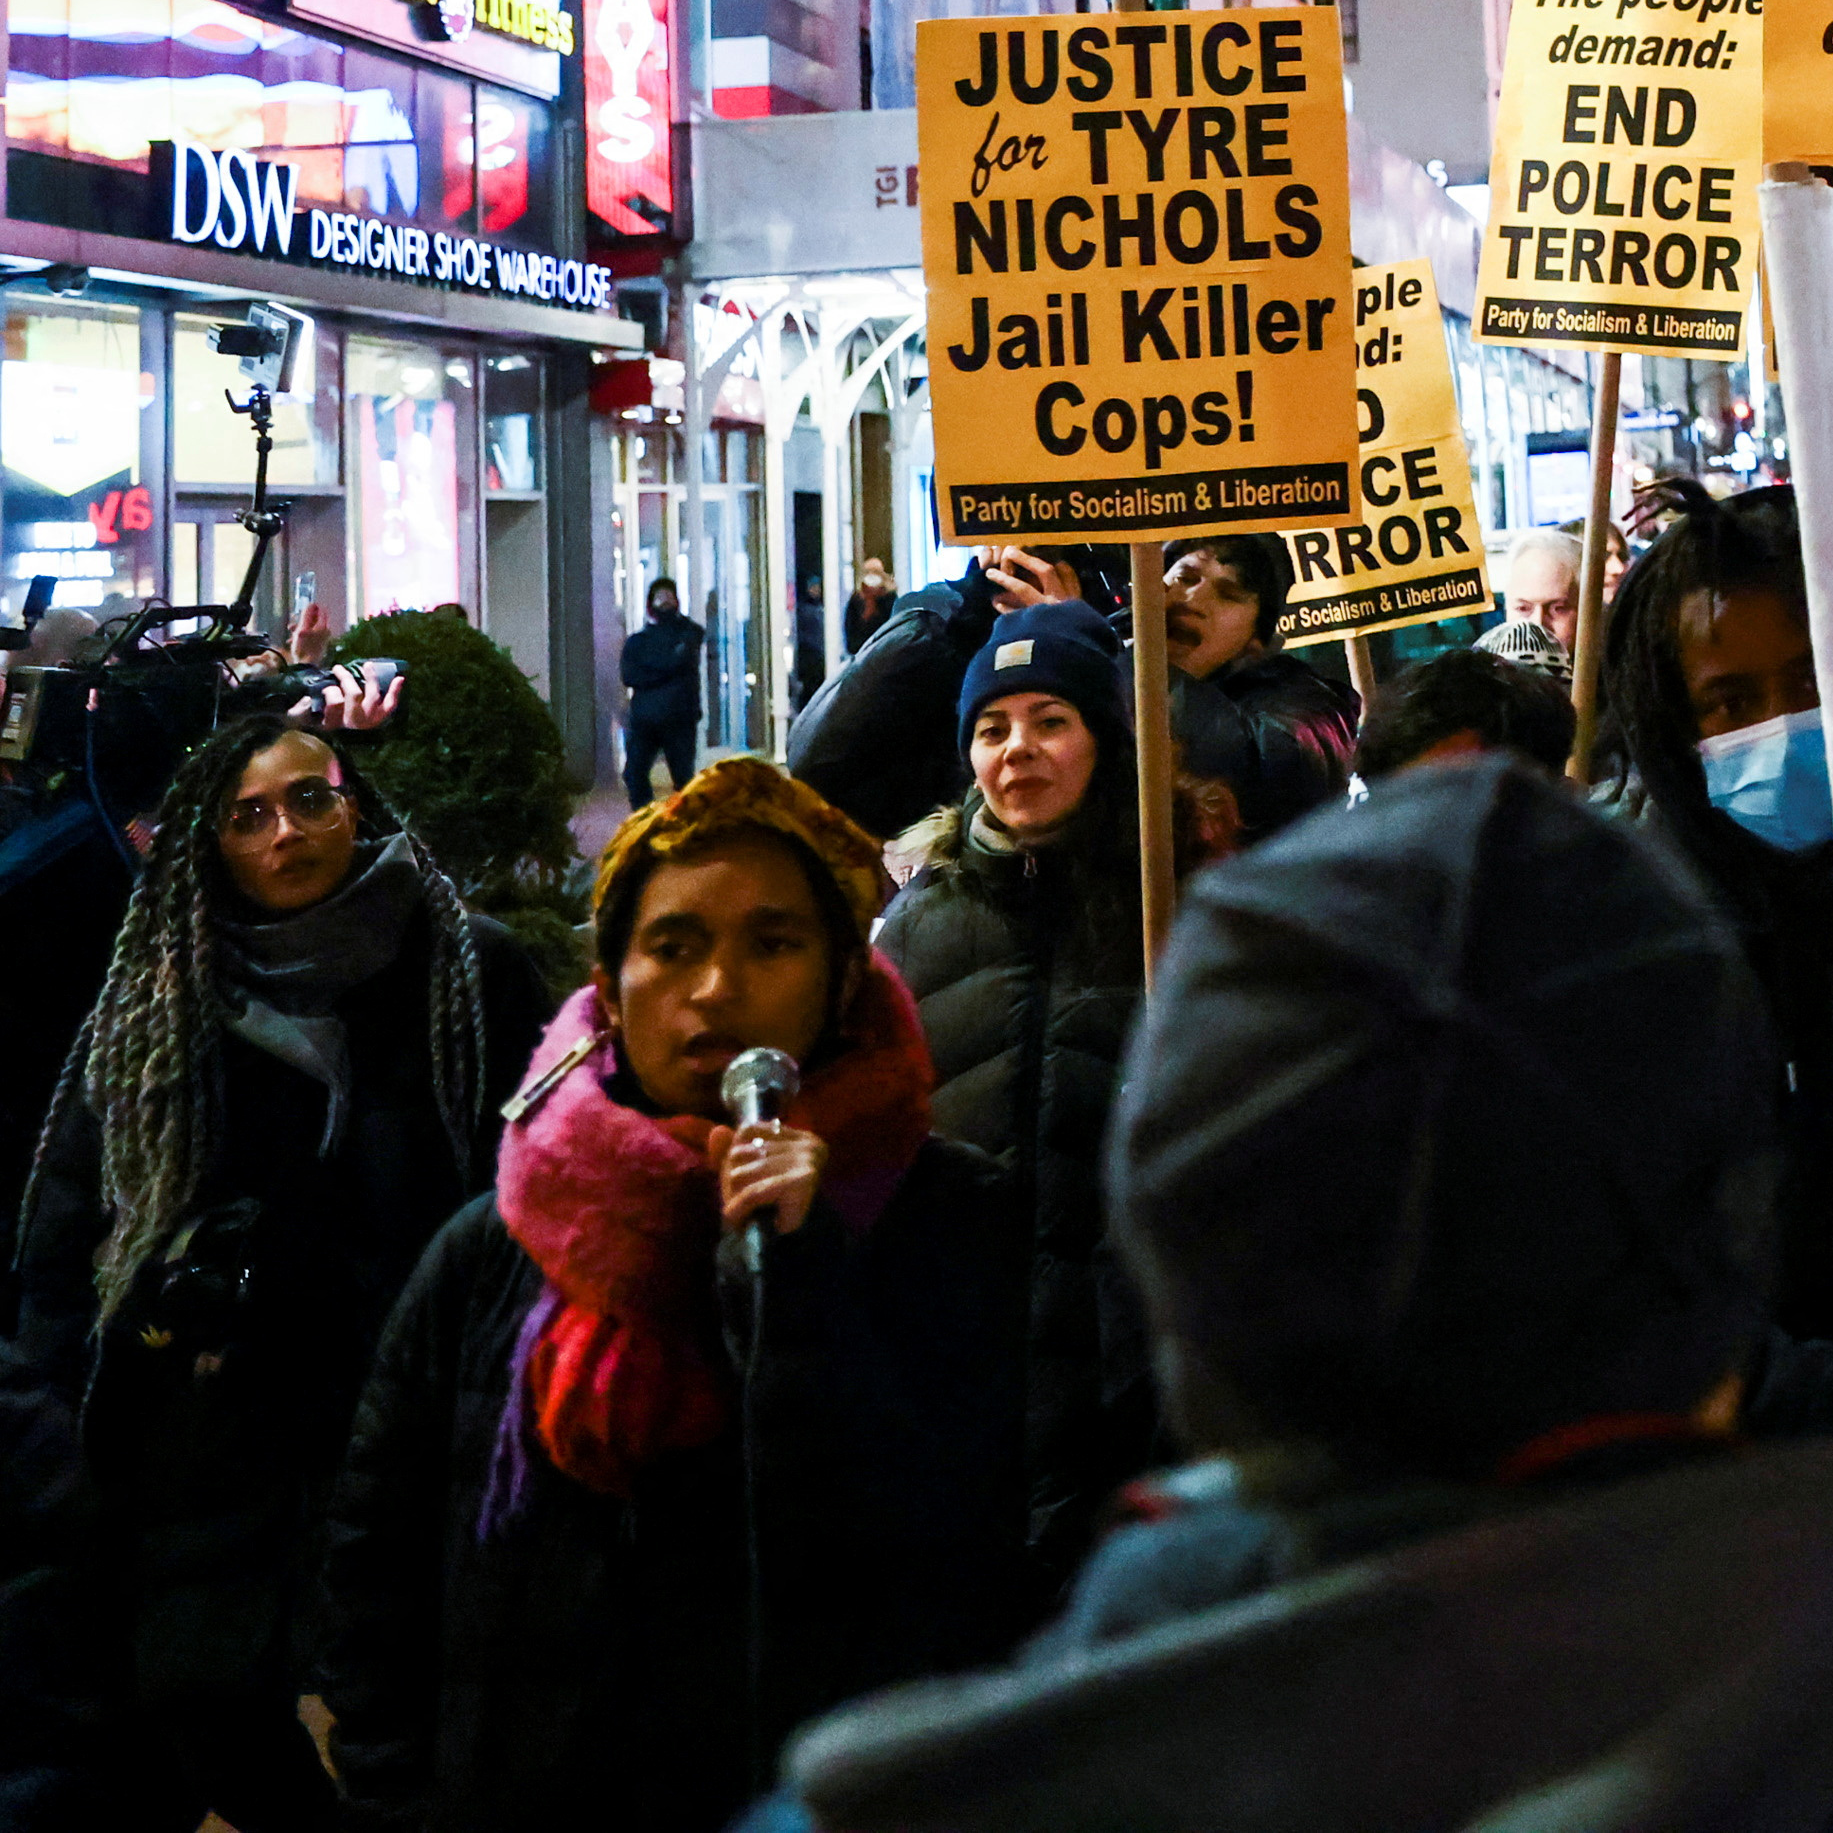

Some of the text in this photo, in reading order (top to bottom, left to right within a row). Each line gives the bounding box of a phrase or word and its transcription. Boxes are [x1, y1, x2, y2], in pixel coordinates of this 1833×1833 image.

[955, 20, 1306, 106] JUSTICE
[1548, 26, 1738, 70] demand:
[971, 103, 1292, 197] for TYRE
[1563, 85, 1696, 147] END
[173, 140, 613, 309] DSW DESIGNER SHOE WAREHOUSE
[1518, 160, 1735, 222] POLICE
[953, 184, 1322, 274] NICHOLS
[1498, 226, 1741, 291] TERROR
[948, 294, 1090, 372] Jail
[1121, 284, 1335, 363] Killer
[1487, 304, 1736, 342] Party for Socialism & Liberation
[1035, 371, 1255, 469] Cops!
[960, 495, 1022, 526] Party
[1029, 491, 1063, 519] for
[1069, 484, 1187, 518] Socialism
[1194, 483, 1212, 510] &
[1219, 476, 1340, 508] Liberation
[1294, 506, 1469, 582] RROR
[1299, 596, 1375, 629] Socialism
[1380, 592, 1392, 612] &
[1395, 579, 1478, 610] Liberation
